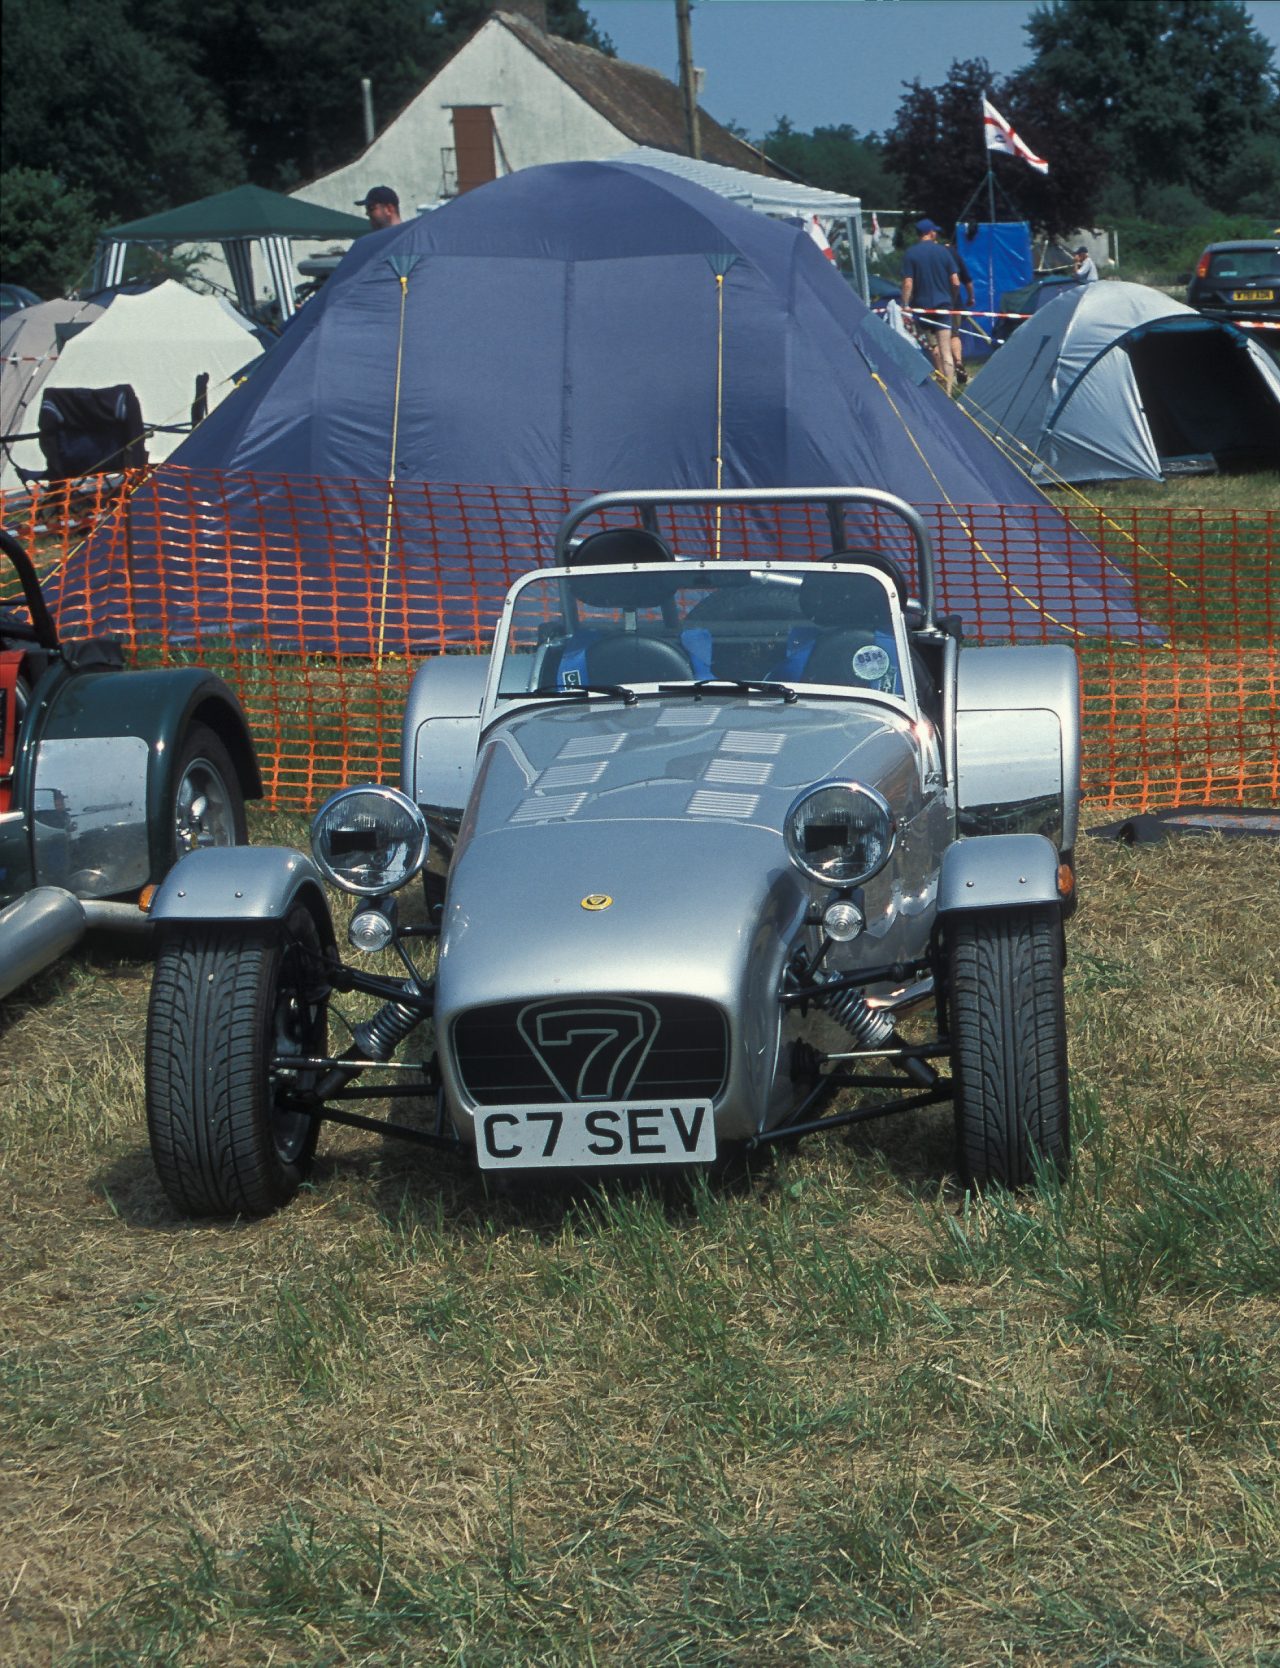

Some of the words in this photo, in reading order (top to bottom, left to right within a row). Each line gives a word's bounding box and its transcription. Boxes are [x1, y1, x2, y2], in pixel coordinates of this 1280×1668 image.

[536, 1008, 644, 1100] 7
[483, 1111, 563, 1159] C7
[585, 1106, 706, 1156] SEV
